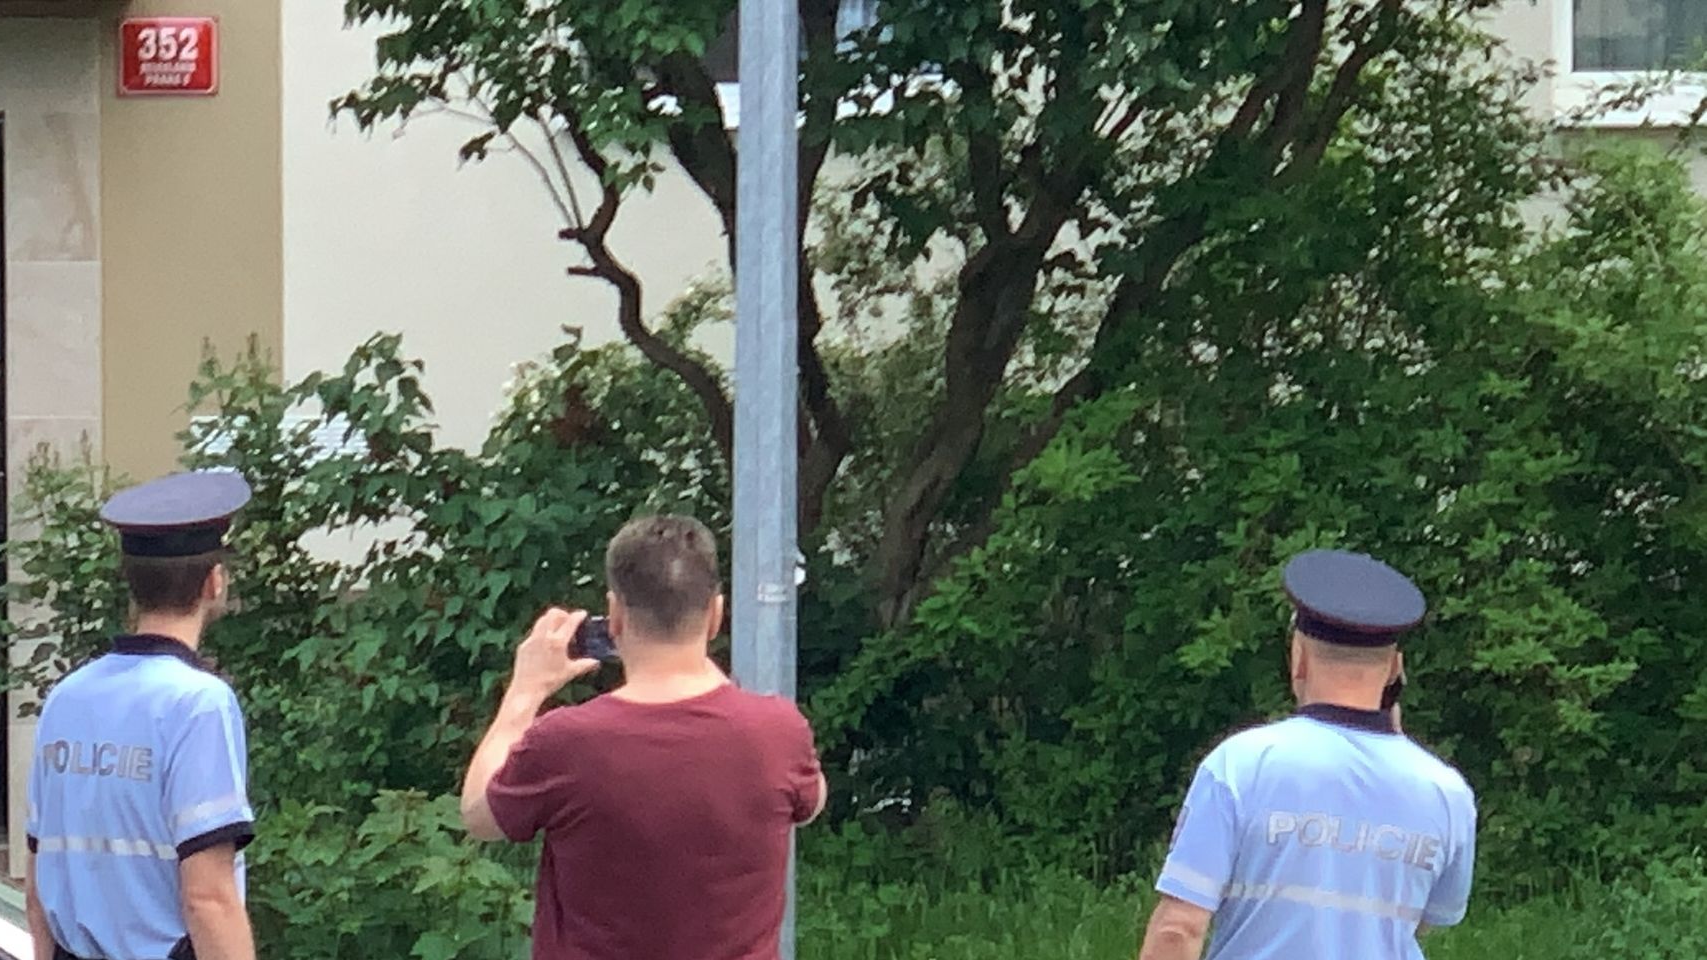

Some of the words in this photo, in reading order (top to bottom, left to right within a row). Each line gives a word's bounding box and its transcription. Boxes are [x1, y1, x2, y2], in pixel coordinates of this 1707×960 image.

[137, 26, 199, 60] 352
[43, 739, 153, 781] POLICIE
[1266, 810, 1440, 871] POLICIE
